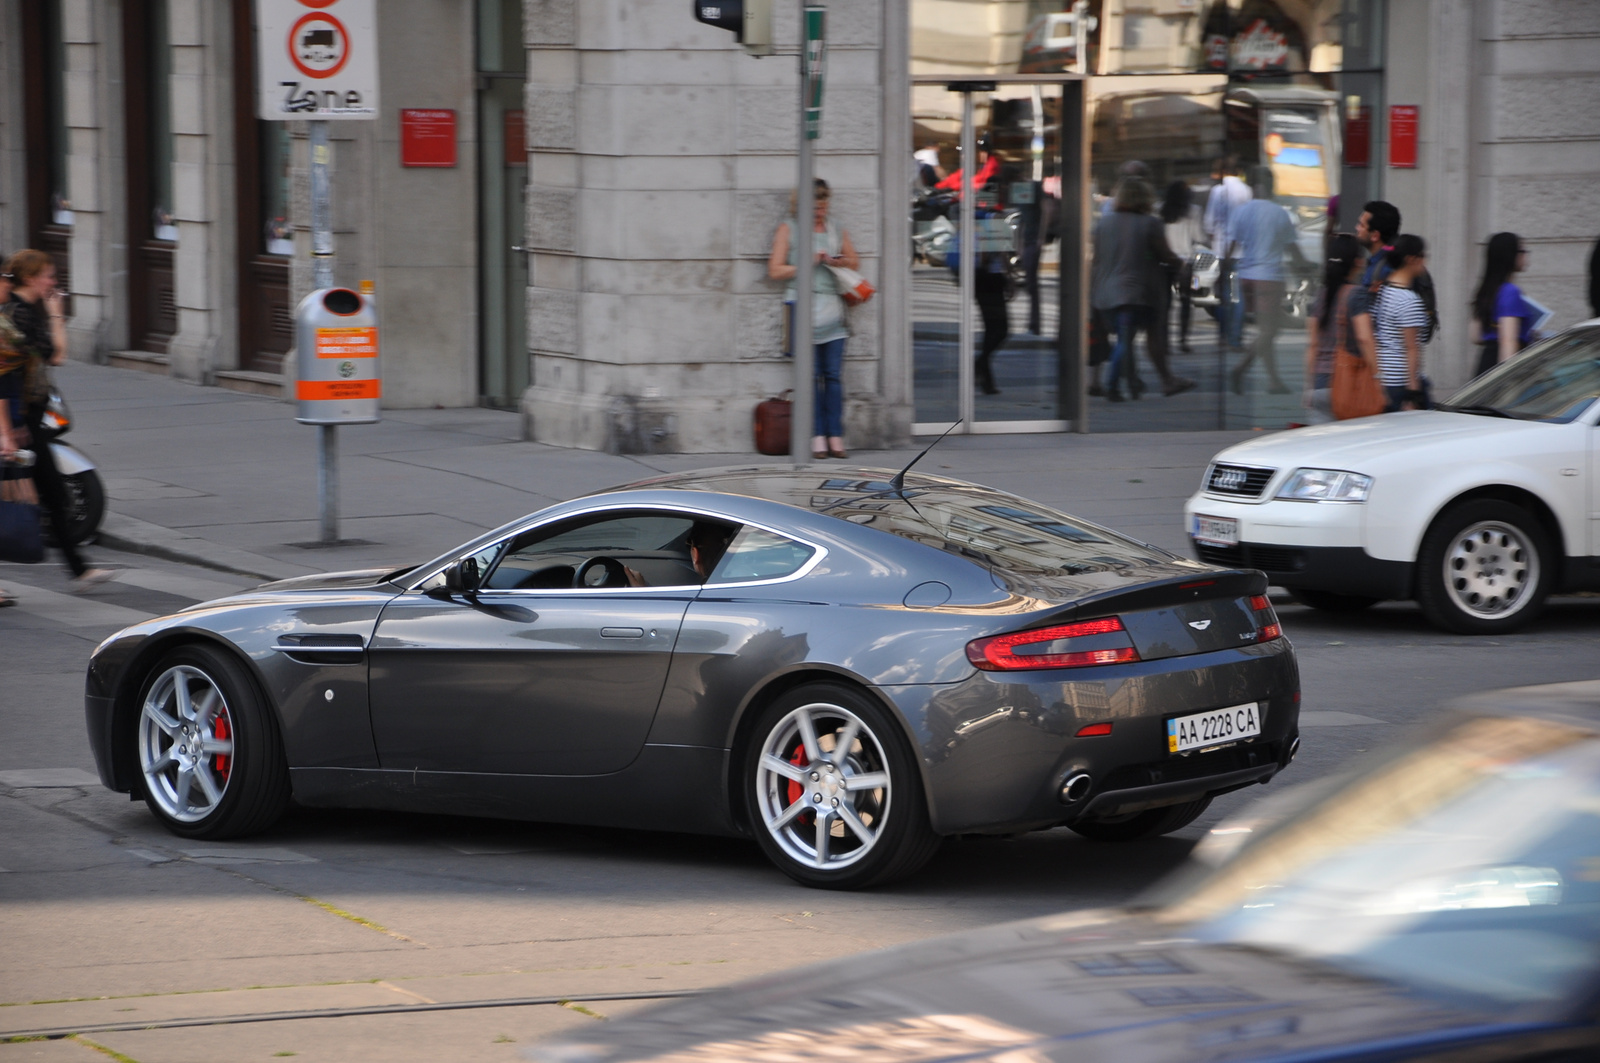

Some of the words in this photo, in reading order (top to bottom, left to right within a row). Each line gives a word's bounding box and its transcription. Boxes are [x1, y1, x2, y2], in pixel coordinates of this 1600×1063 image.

[279, 81, 362, 112] Zone
[1179, 720, 1198, 746] AA
[1201, 713, 1233, 740] 2228
[1236, 708, 1256, 732] CA
